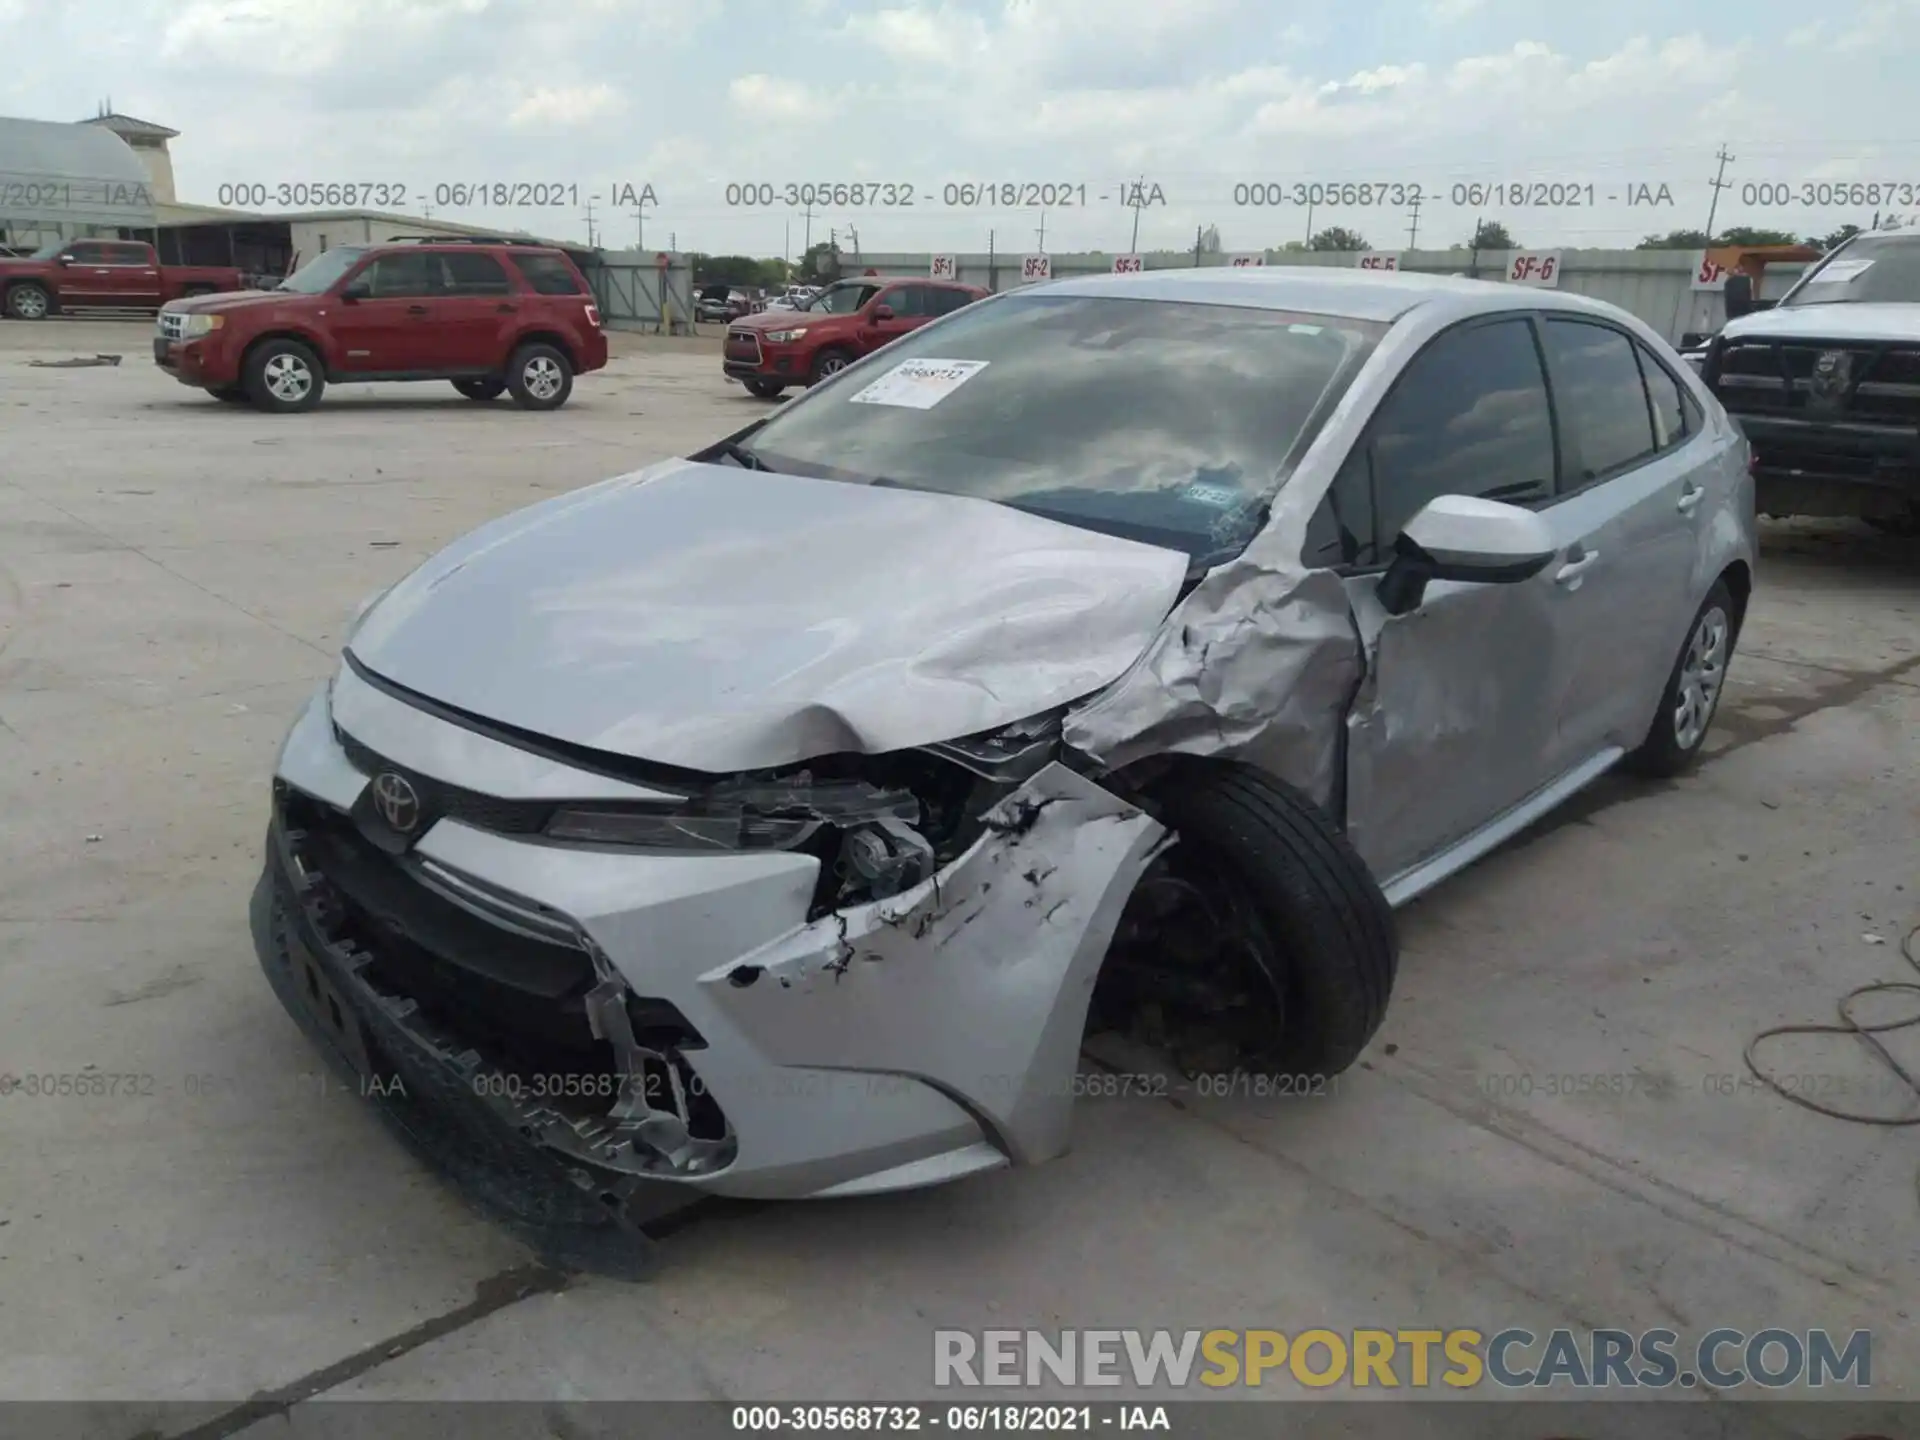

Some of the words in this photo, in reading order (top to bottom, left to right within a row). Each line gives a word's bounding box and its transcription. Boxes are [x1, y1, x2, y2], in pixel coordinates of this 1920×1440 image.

[934, 258, 952, 274] SF-1
[1025, 258, 1047, 277] SF-2
[1511, 256, 1555, 280] SF-6
